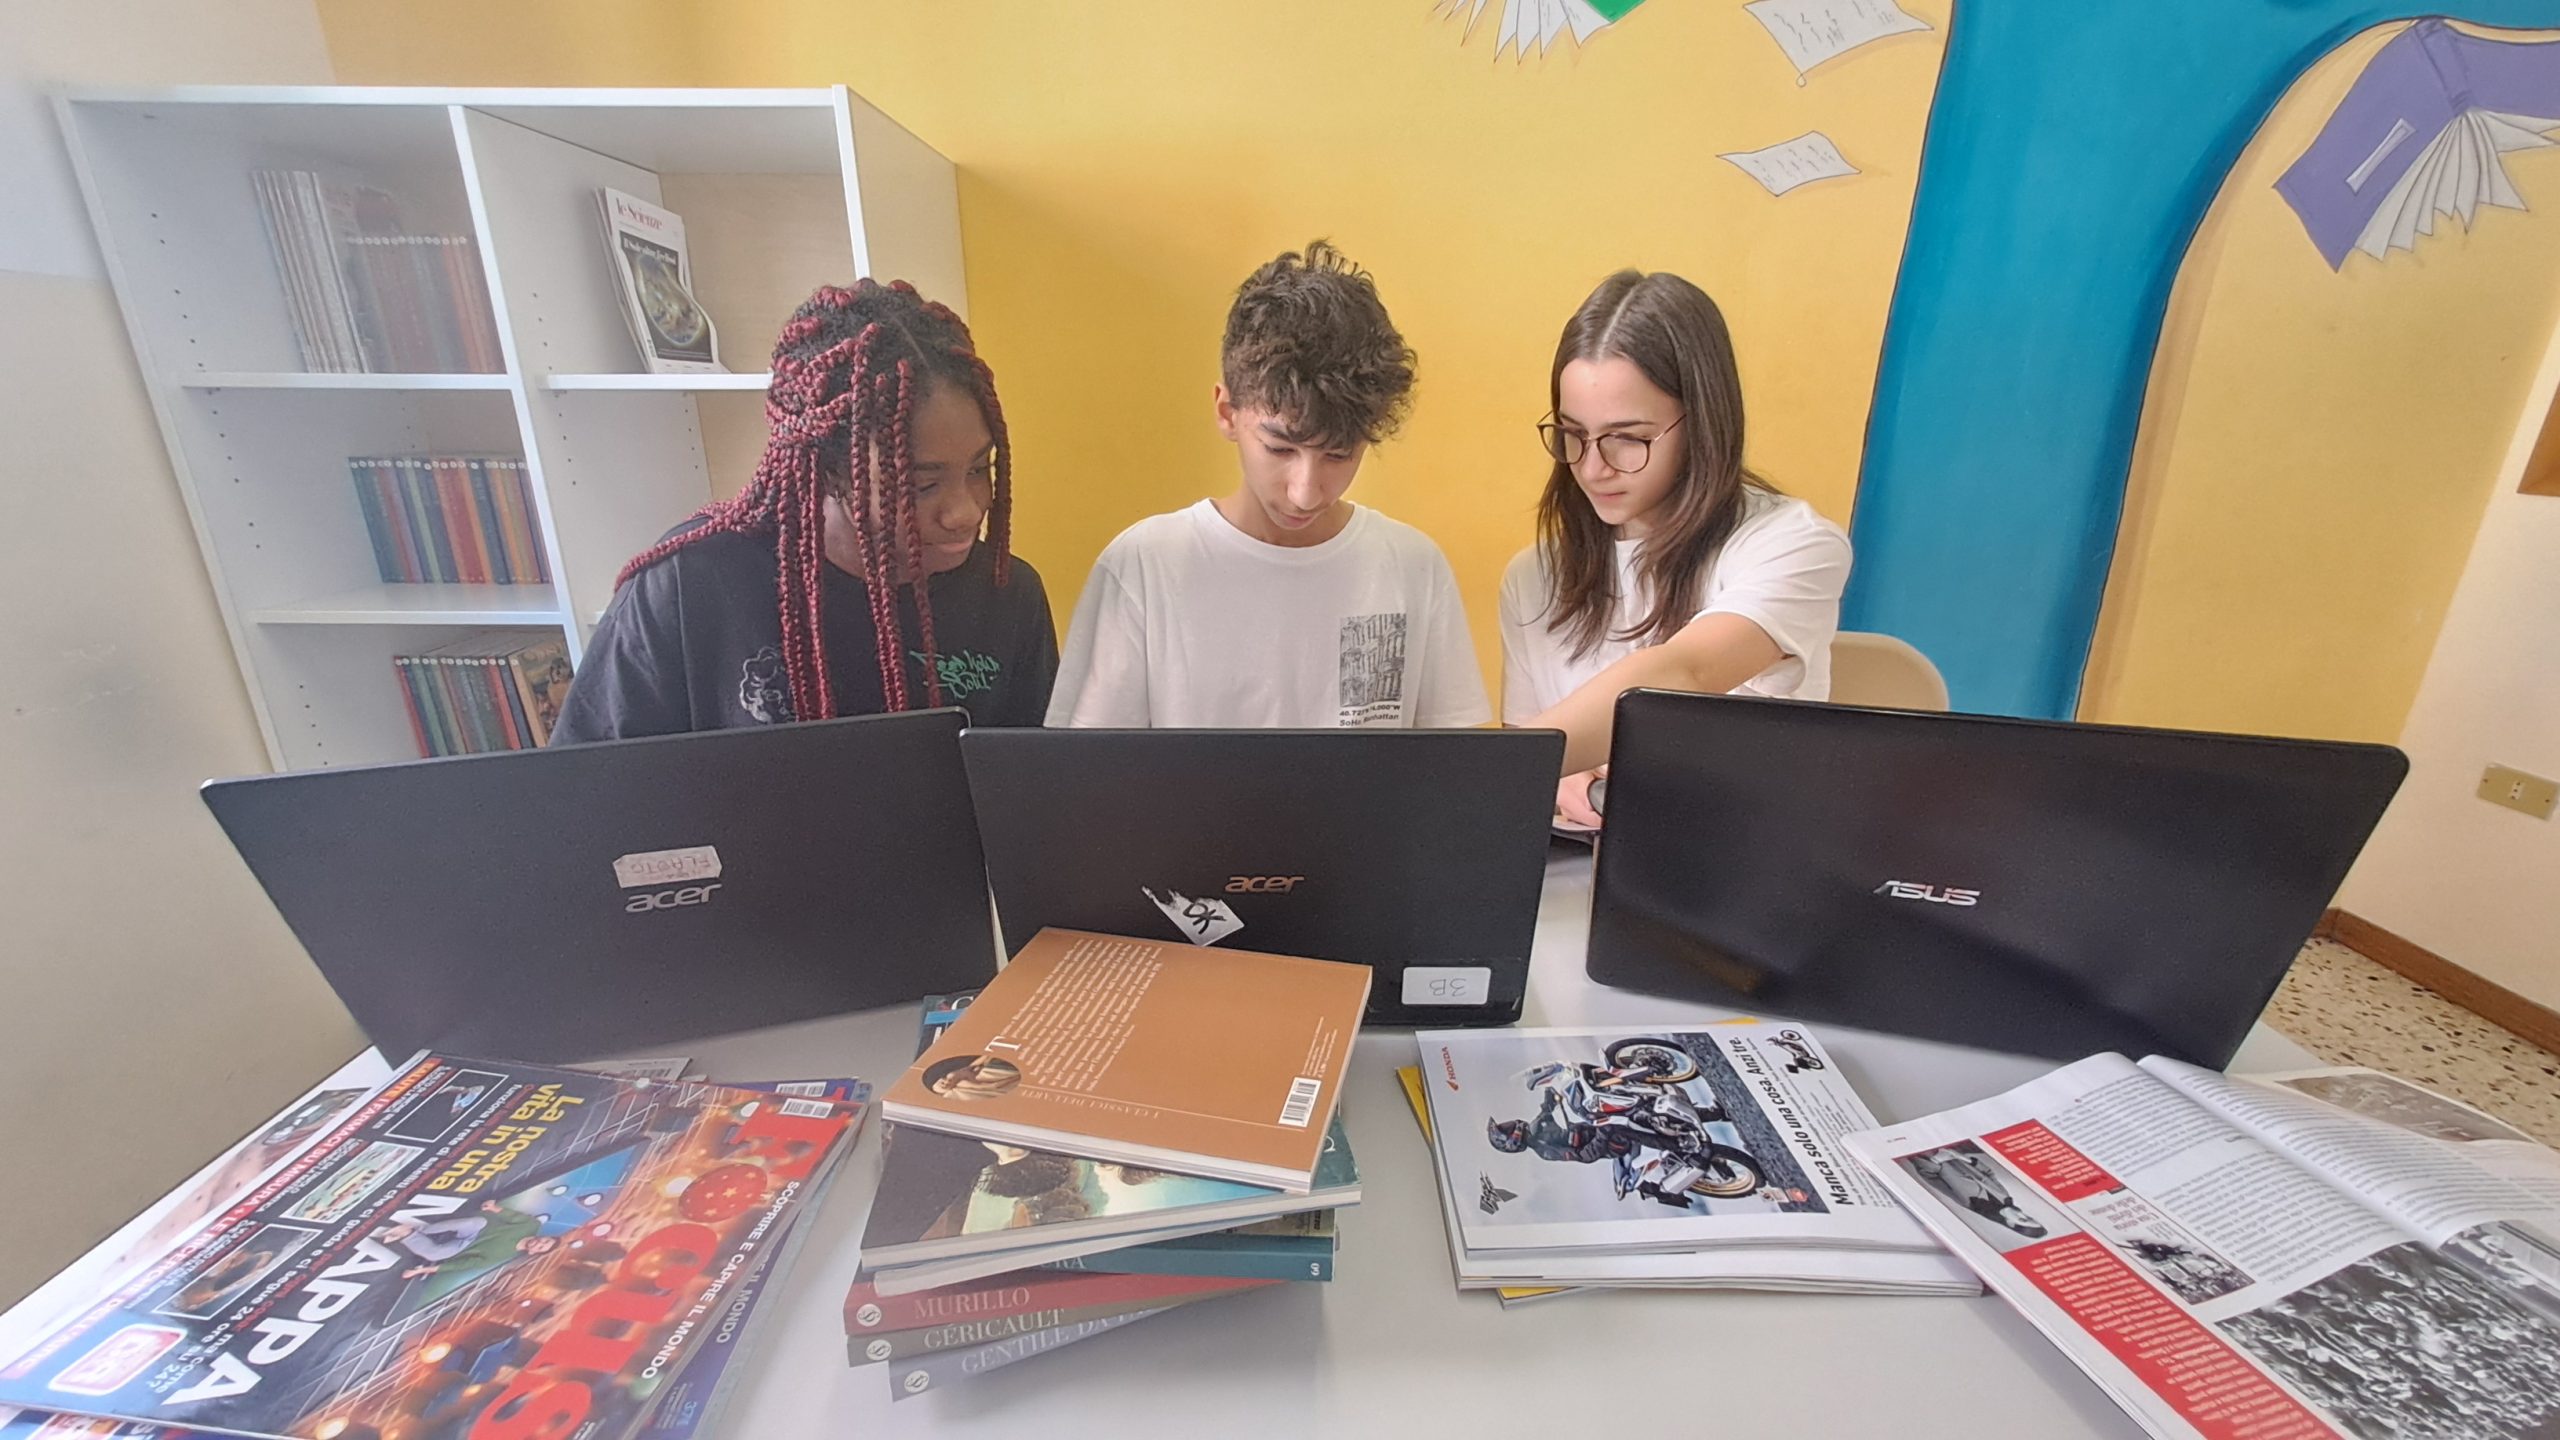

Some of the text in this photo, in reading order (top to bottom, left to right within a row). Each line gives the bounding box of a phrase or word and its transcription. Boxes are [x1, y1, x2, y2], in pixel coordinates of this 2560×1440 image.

[625, 883, 722, 913] acer
[1225, 876, 1304, 893] acer
[1873, 880, 1980, 906] ASUS
[1442, 1047, 1456, 1080] HONDA
[1735, 1054, 1765, 1076] Anzi
[1759, 1077, 1785, 1106] cosa.
[424, 1081, 566, 1191] vita in una
[1778, 1107, 1802, 1129] una
[452, 1096, 585, 1194] La nostra
[1794, 1131, 1822, 1159] solo
[1815, 1160, 1854, 1206] Manca
[748, 1181, 800, 1240] SCOPRIRE
[700, 1253, 744, 1303] CAPIRE
[161, 1188, 468, 1406] MAPPA
[688, 1304, 707, 1318] IL
[914, 1287, 1030, 1320] MURILLO
[716, 1289, 753, 1343] MONDO
[924, 1308, 1065, 1349] GÉRICAULT
[641, 1320, 694, 1379] MONDO
[961, 1327, 1069, 1374] GENTILE
